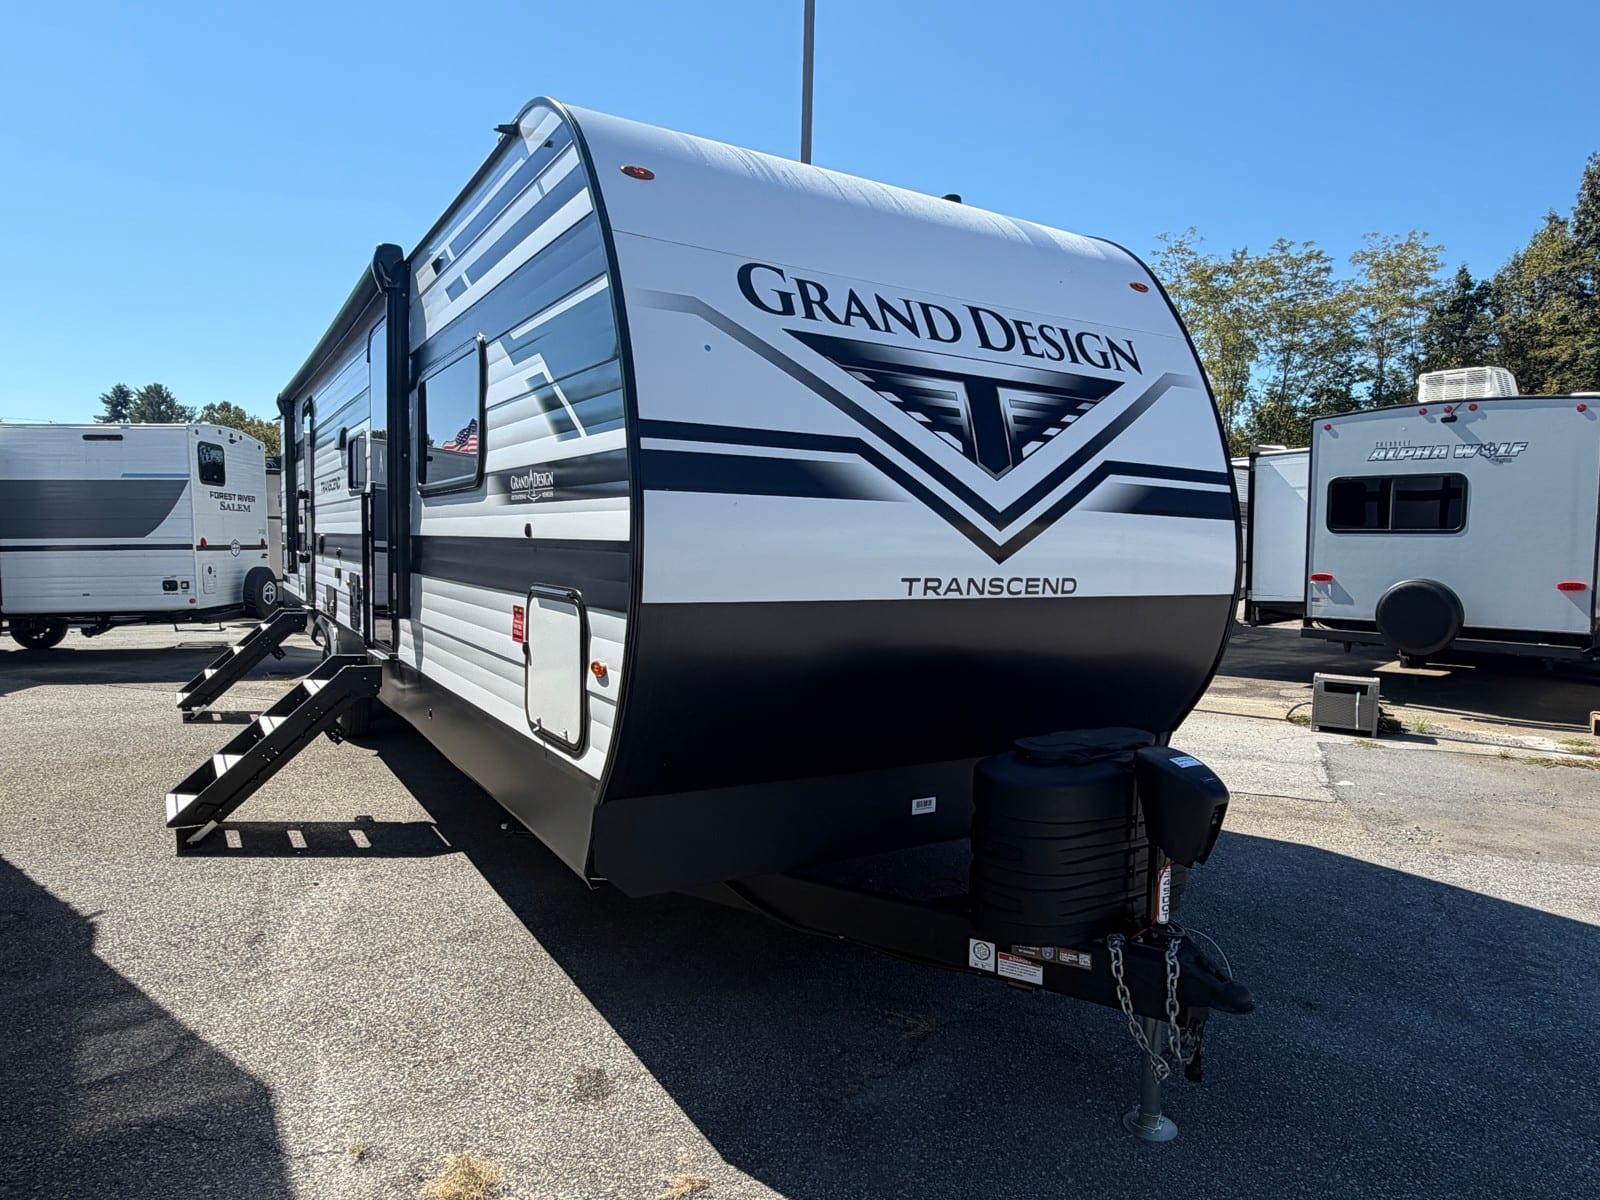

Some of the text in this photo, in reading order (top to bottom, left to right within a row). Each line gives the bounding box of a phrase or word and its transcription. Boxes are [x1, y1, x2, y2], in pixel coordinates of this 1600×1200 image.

[736, 262, 1143, 375] GRAND DESIGN
[1367, 444, 1450, 462] ALPHA
[209, 490, 256, 503] FOREST RIVER
[219, 501, 251, 513] SALEM
[900, 577, 1077, 597] TRANSCEND
